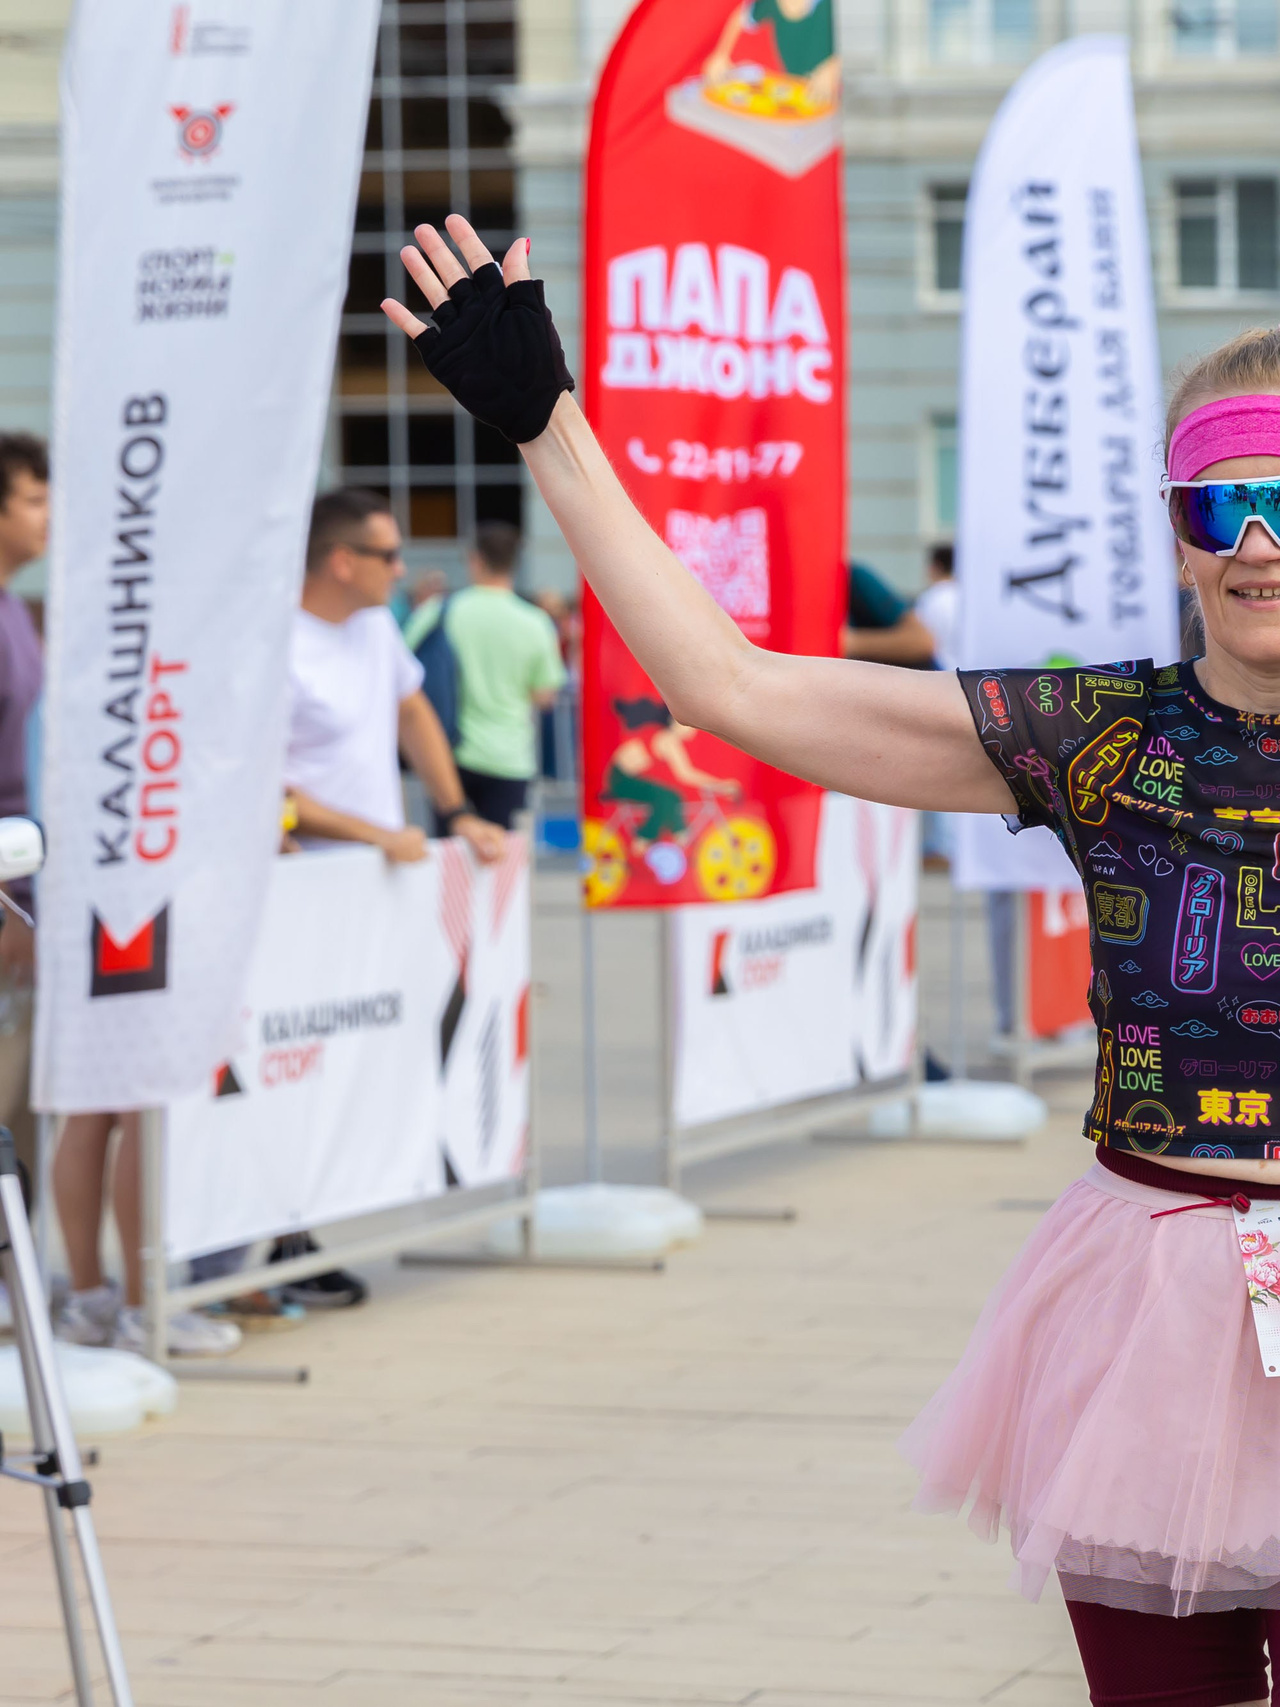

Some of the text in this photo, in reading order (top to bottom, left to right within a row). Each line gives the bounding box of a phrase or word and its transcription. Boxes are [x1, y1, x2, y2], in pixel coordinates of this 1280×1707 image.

[607, 241, 829, 345] ПАПА
[601, 332, 833, 404] ДЖОНС
[95, 391, 168, 868] КАЛАШНИКОВ
[1038, 676, 1054, 713] LOVE
[135, 650, 188, 864] СПОРТ
[1139, 756, 1185, 783] LOVE
[1132, 773, 1184, 806] LOVE
[1244, 874, 1257, 921] OPEN
[1181, 873, 1216, 983] グローリア
[1118, 1023, 1160, 1046] LOVE
[1120, 1045, 1162, 1069] LOVE
[1180, 1058, 1278, 1080] グローリア
[1119, 1072, 1164, 1093] LOVE
[1197, 1088, 1273, 1127] 東京
